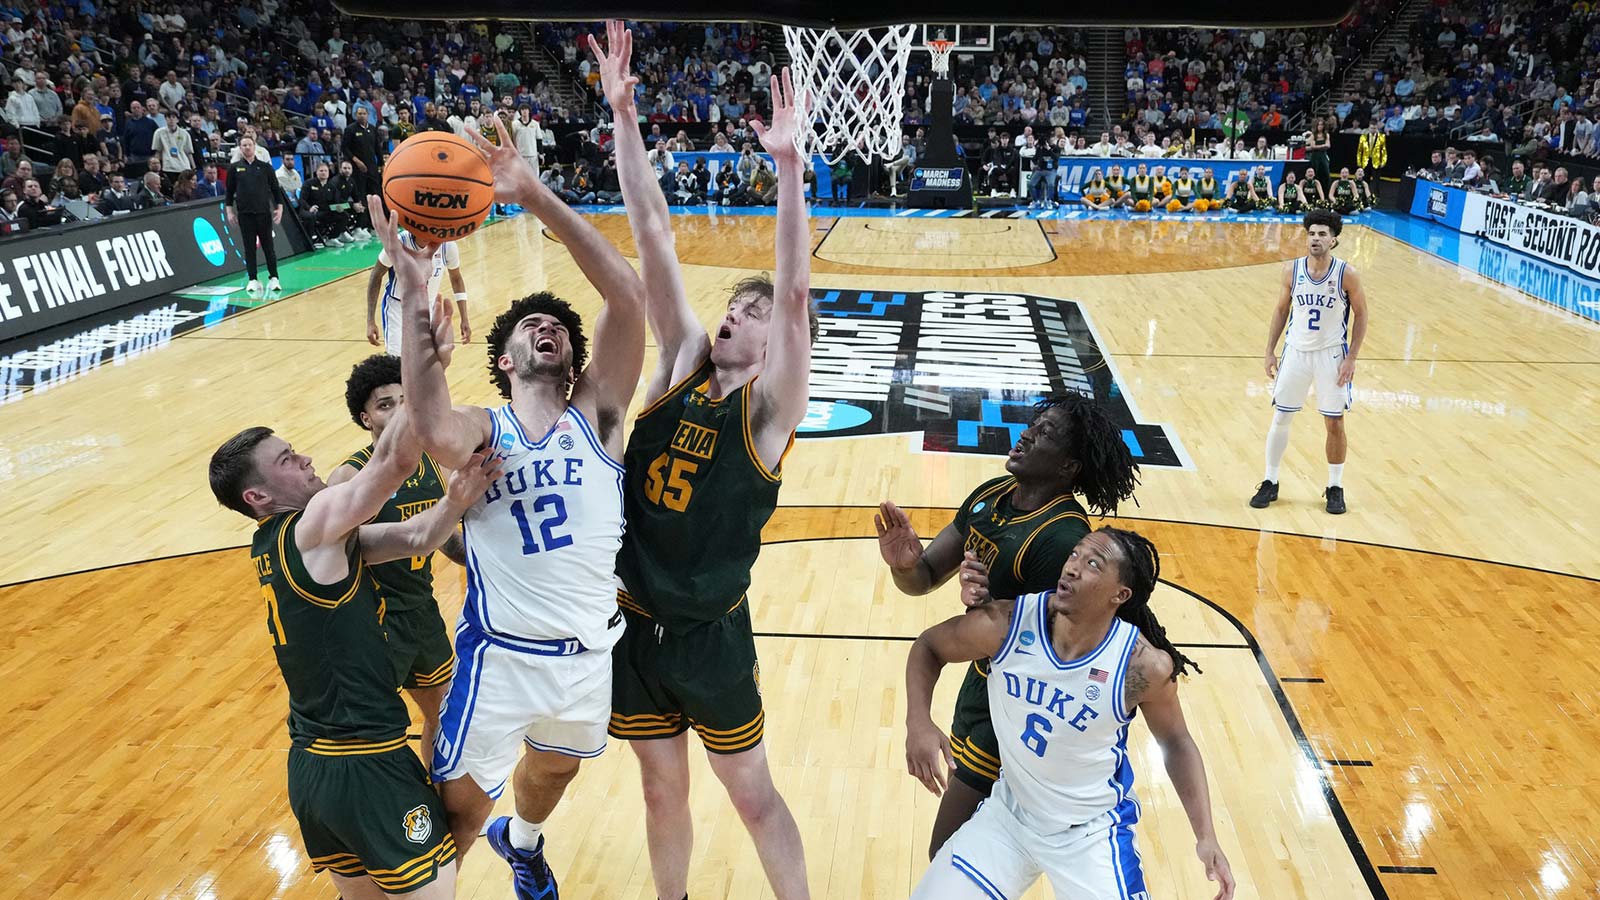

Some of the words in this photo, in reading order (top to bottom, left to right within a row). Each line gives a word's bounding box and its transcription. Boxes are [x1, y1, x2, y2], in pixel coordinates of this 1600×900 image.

[415, 190, 469, 209] NCAA
[923, 170, 949, 178] MARCH
[925, 178, 961, 187] MADNESS
[1485, 200, 1517, 241] FIRST
[1523, 213, 1578, 262] SECOND
[1576, 228, 1600, 271] RO
[12, 245, 107, 314] FINAL
[96, 229, 174, 291] FOUR
[1296, 294, 1336, 309] DUKE
[1308, 309, 1321, 331] 2
[808, 318, 904, 402] MARCH
[912, 291, 1053, 392] MADNESS
[671, 423, 717, 457] ENA
[644, 452, 699, 513] 55
[510, 493, 574, 556] 12
[1003, 671, 1099, 733] DUKE
[1020, 712, 1053, 758] 6
